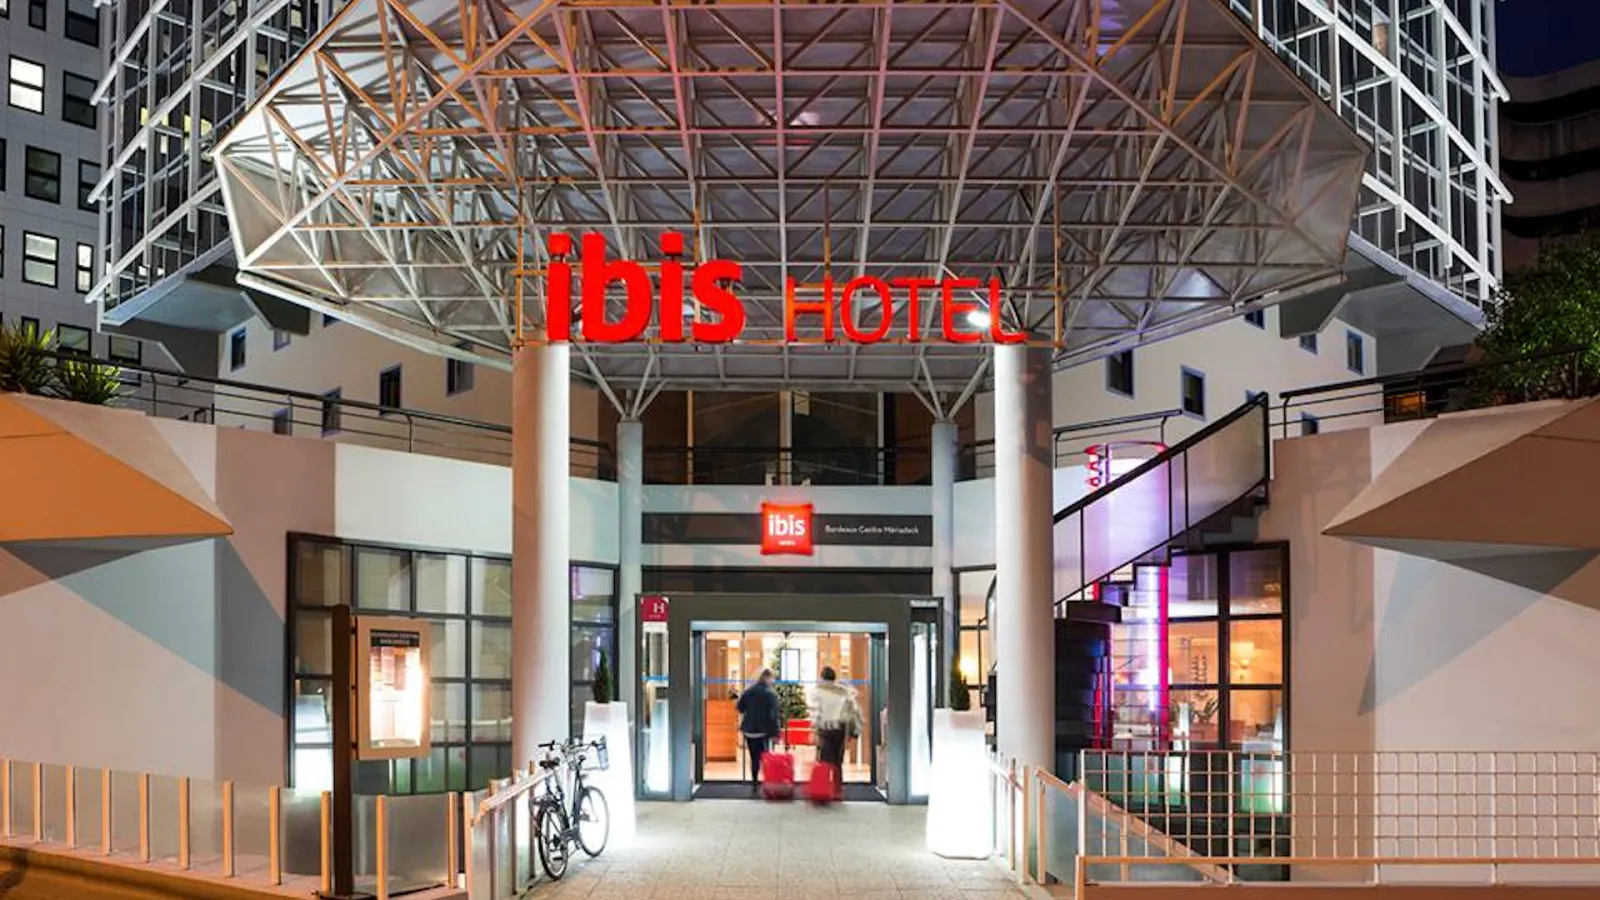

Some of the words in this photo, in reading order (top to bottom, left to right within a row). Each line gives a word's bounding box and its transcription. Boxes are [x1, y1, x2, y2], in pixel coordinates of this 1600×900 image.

[547, 232, 746, 343] ibis
[786, 276, 1028, 343] HOTEL
[768, 514, 806, 536] ibis
[653, 602, 665, 614] H
